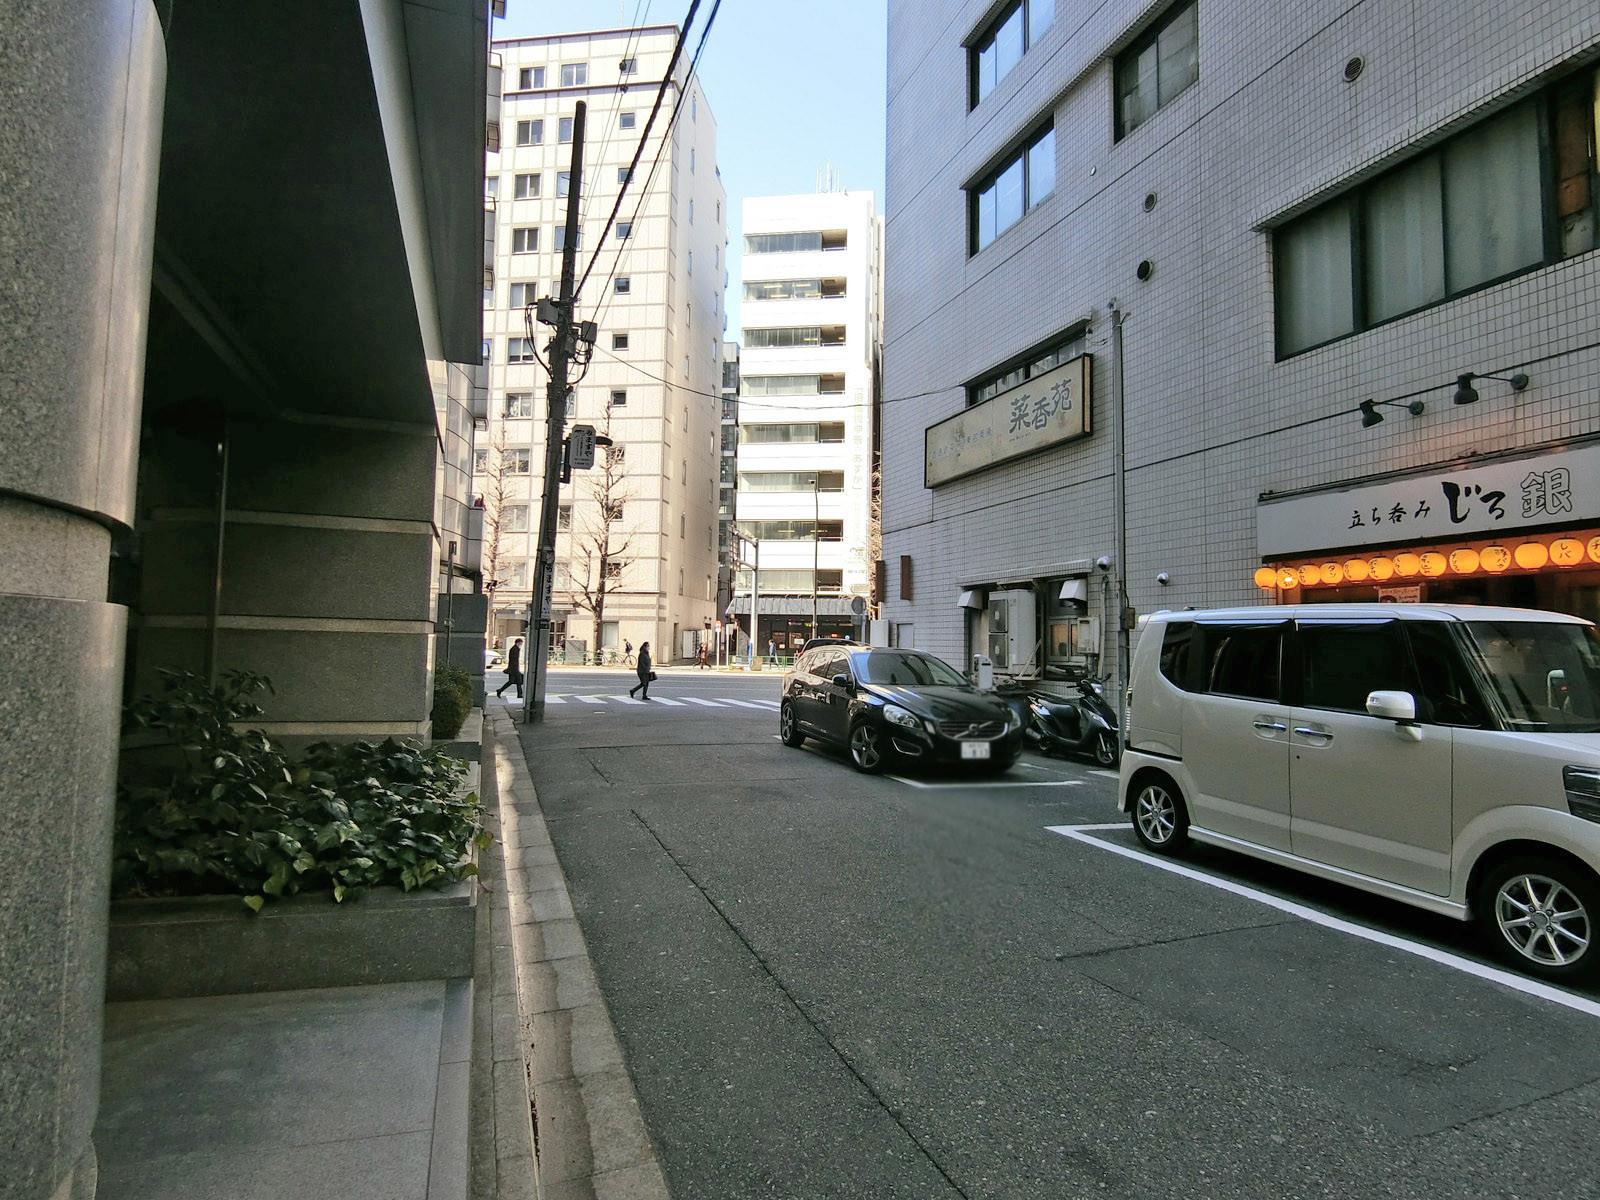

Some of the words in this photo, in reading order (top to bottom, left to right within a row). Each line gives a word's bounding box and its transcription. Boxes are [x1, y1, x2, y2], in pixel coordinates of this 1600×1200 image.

[1009, 378, 1072, 434] 菜香苑
[1347, 500, 1431, 530] 立ち呑み
